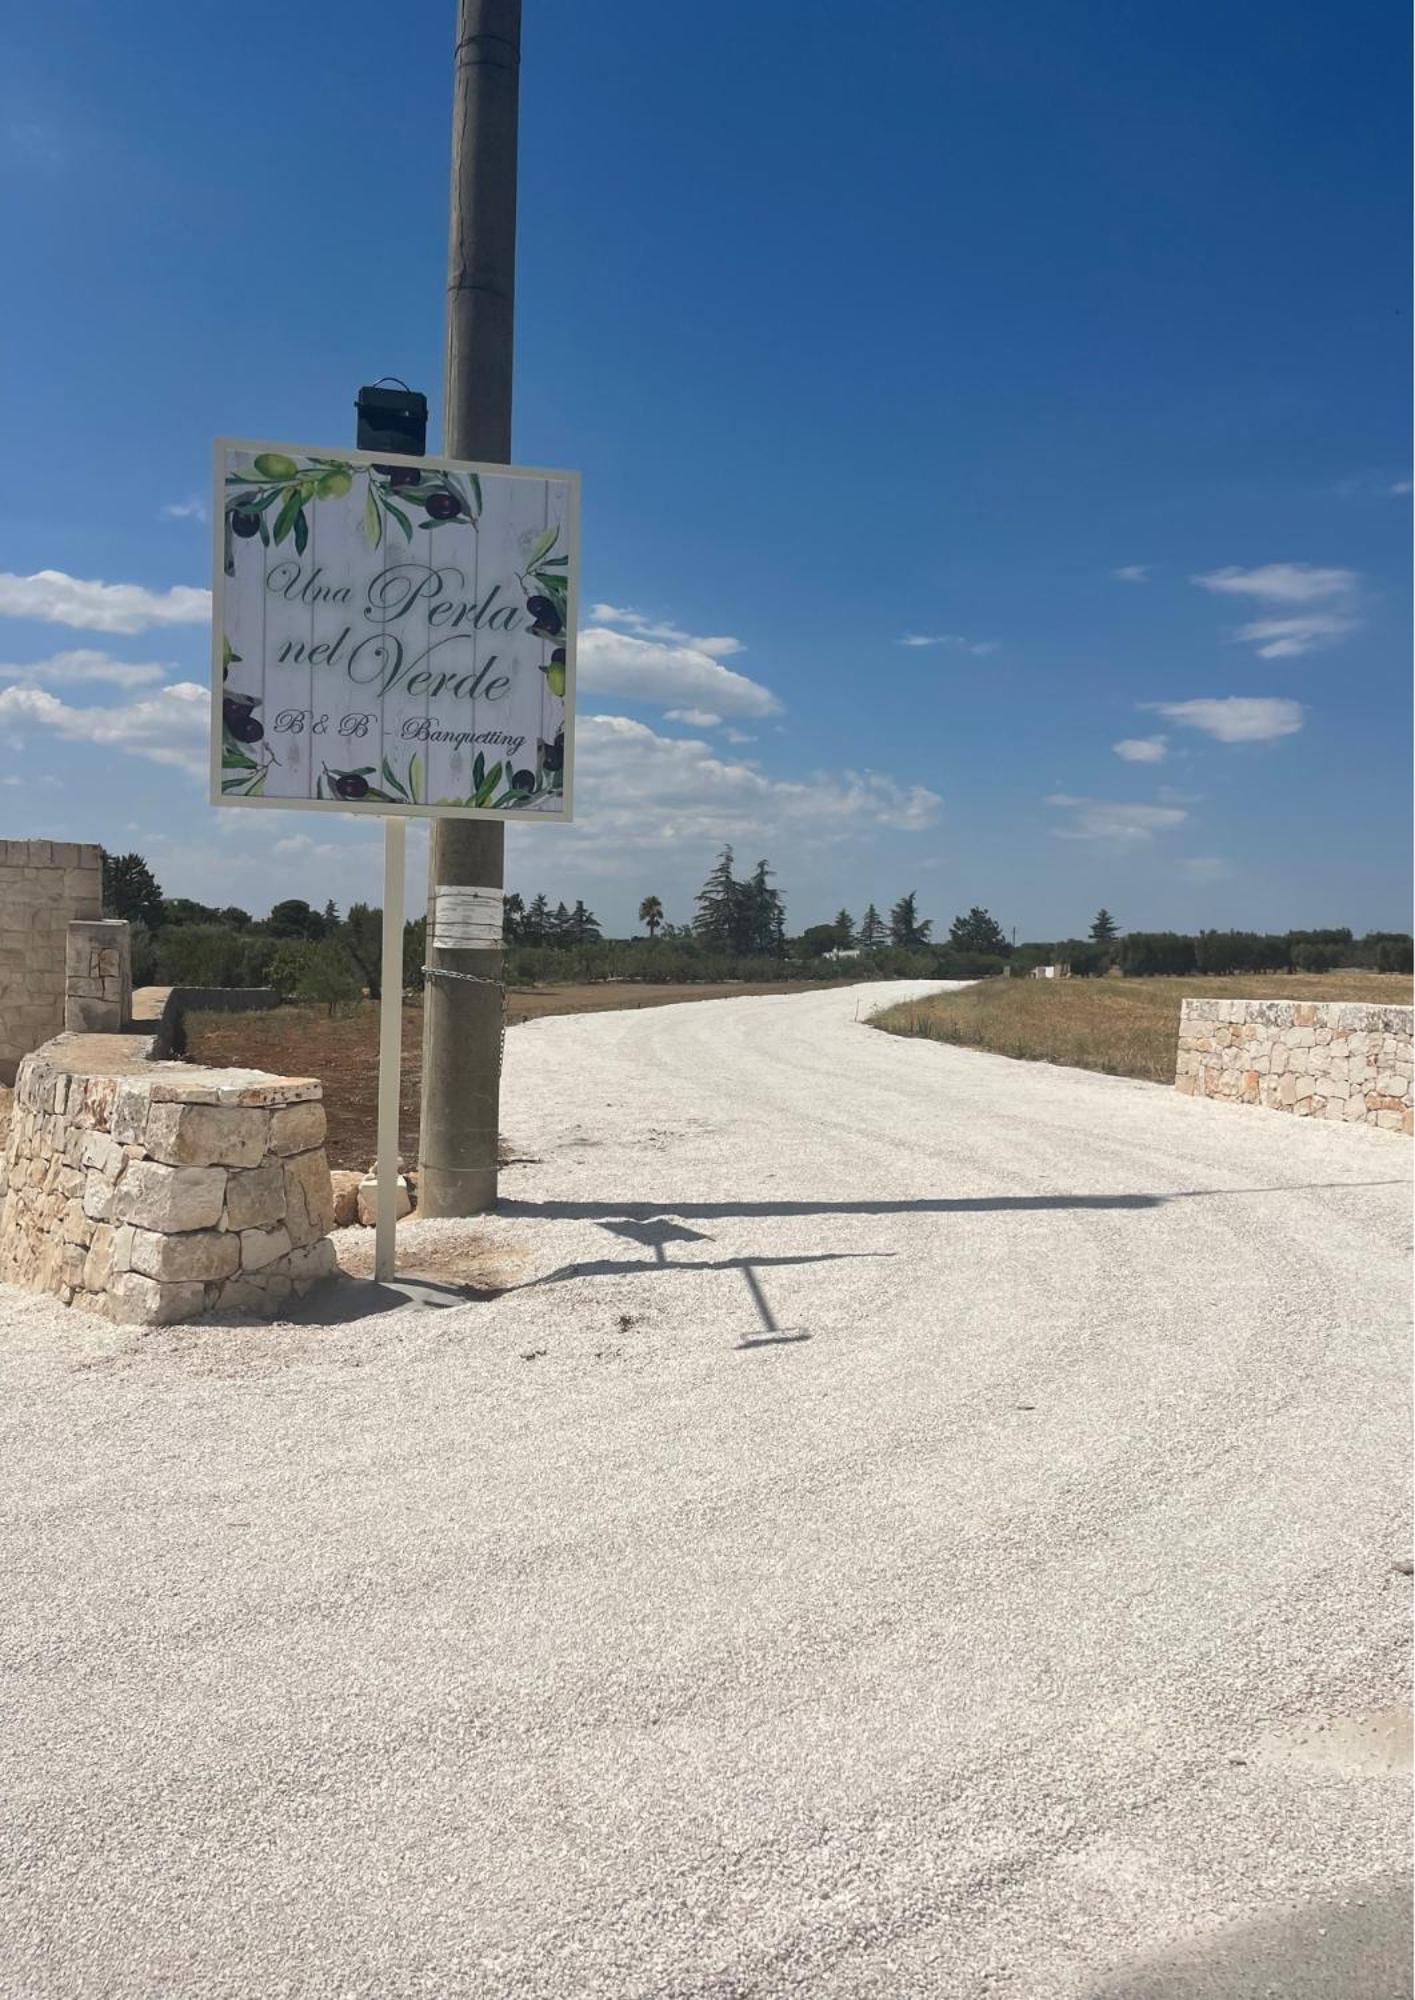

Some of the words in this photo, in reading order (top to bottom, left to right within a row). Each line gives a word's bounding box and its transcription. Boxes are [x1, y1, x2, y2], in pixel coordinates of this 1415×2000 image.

[266, 561, 352, 603] Una
[364, 563, 523, 631] Perla
[278, 627, 351, 667] nel
[347, 633, 512, 701] Verde
[273, 708, 313, 735] B
[312, 714, 329, 736] &
[338, 712, 378, 738] B
[400, 716, 527, 755] Banquetting
